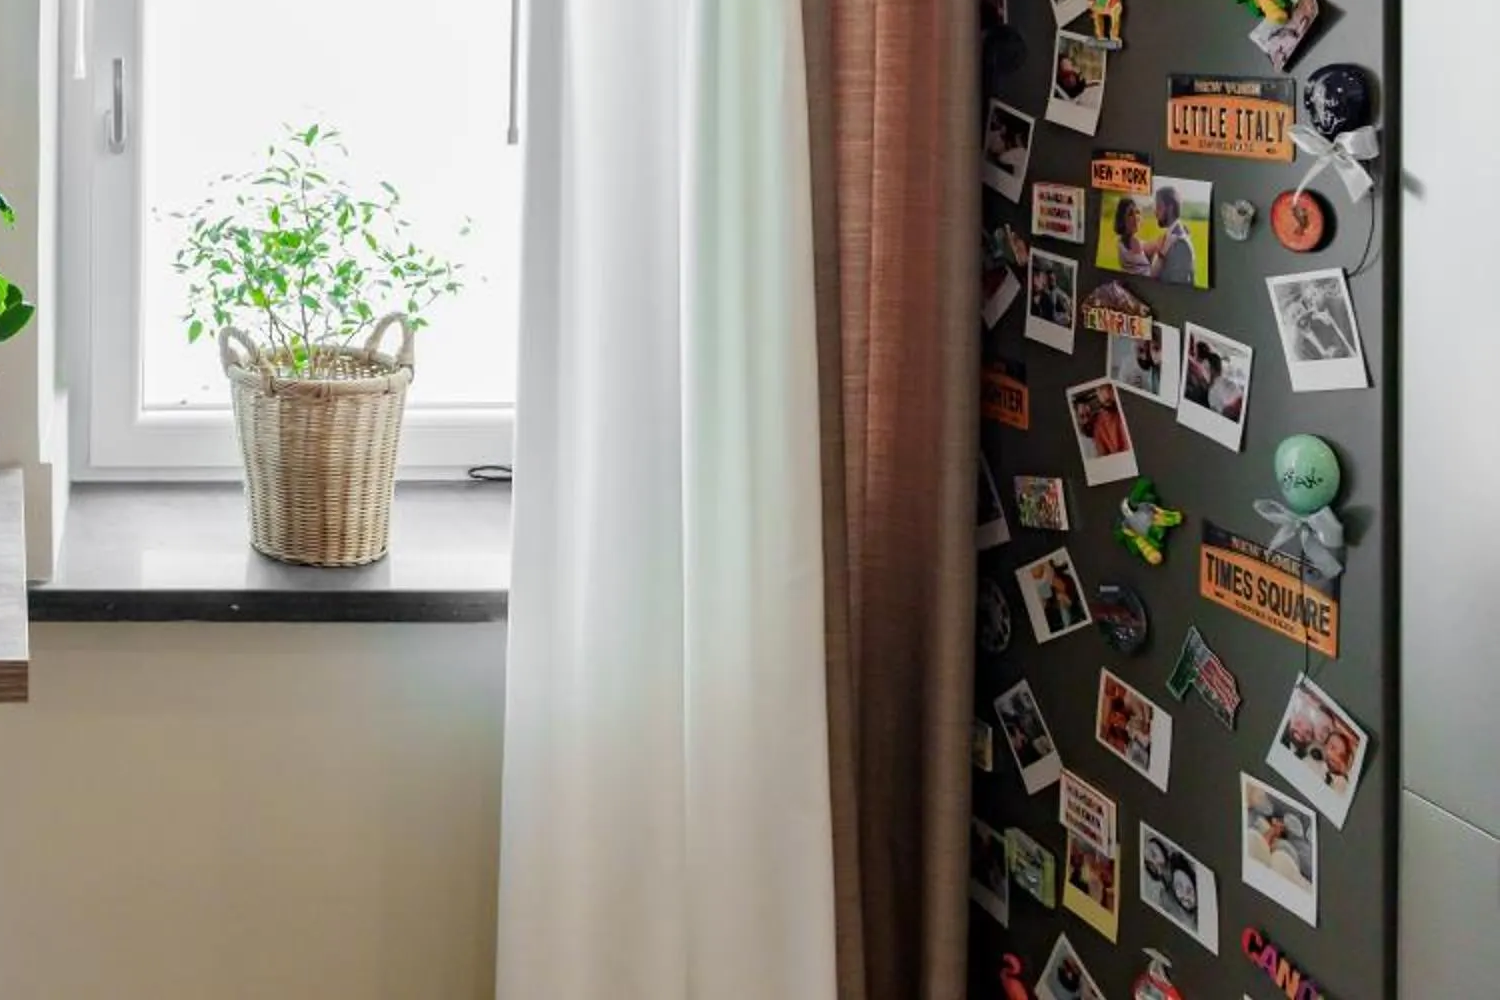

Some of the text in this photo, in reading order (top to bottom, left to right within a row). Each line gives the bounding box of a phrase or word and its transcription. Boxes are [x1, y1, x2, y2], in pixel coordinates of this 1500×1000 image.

[1173, 103, 1285, 143] LITTLE ITALY
[1121, 167, 1148, 186] YORK
[1205, 551, 1253, 601] TIMES
[1257, 575, 1331, 637] SQUARE
